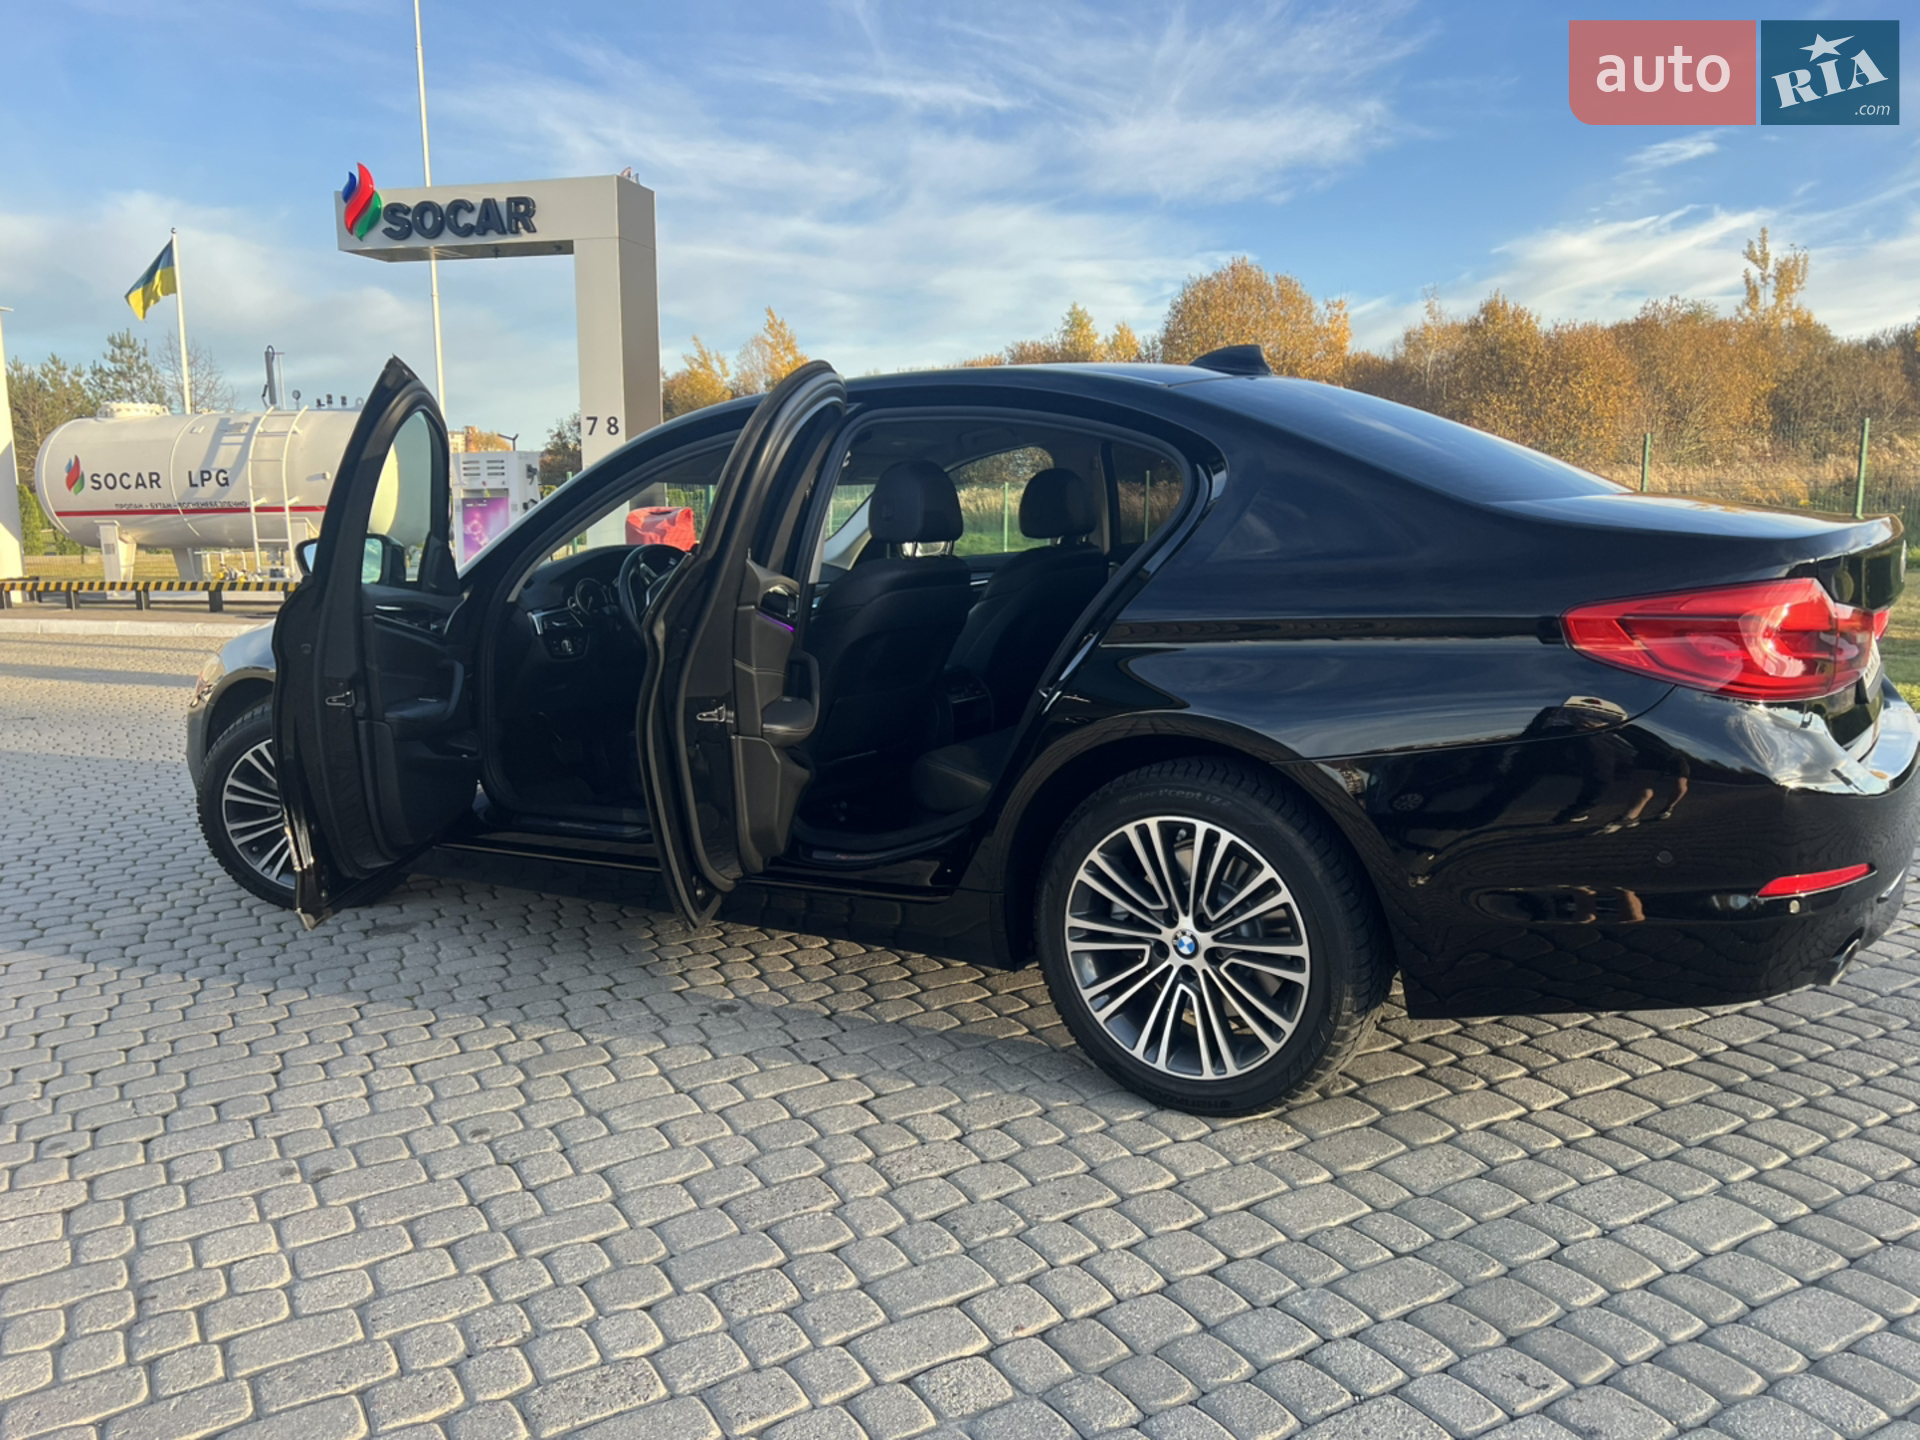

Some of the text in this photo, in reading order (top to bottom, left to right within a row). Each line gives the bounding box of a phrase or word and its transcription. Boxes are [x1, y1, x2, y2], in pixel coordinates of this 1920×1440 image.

[382, 196, 537, 241] SOCAR
[90, 469, 230, 491] SOCAR LPG
